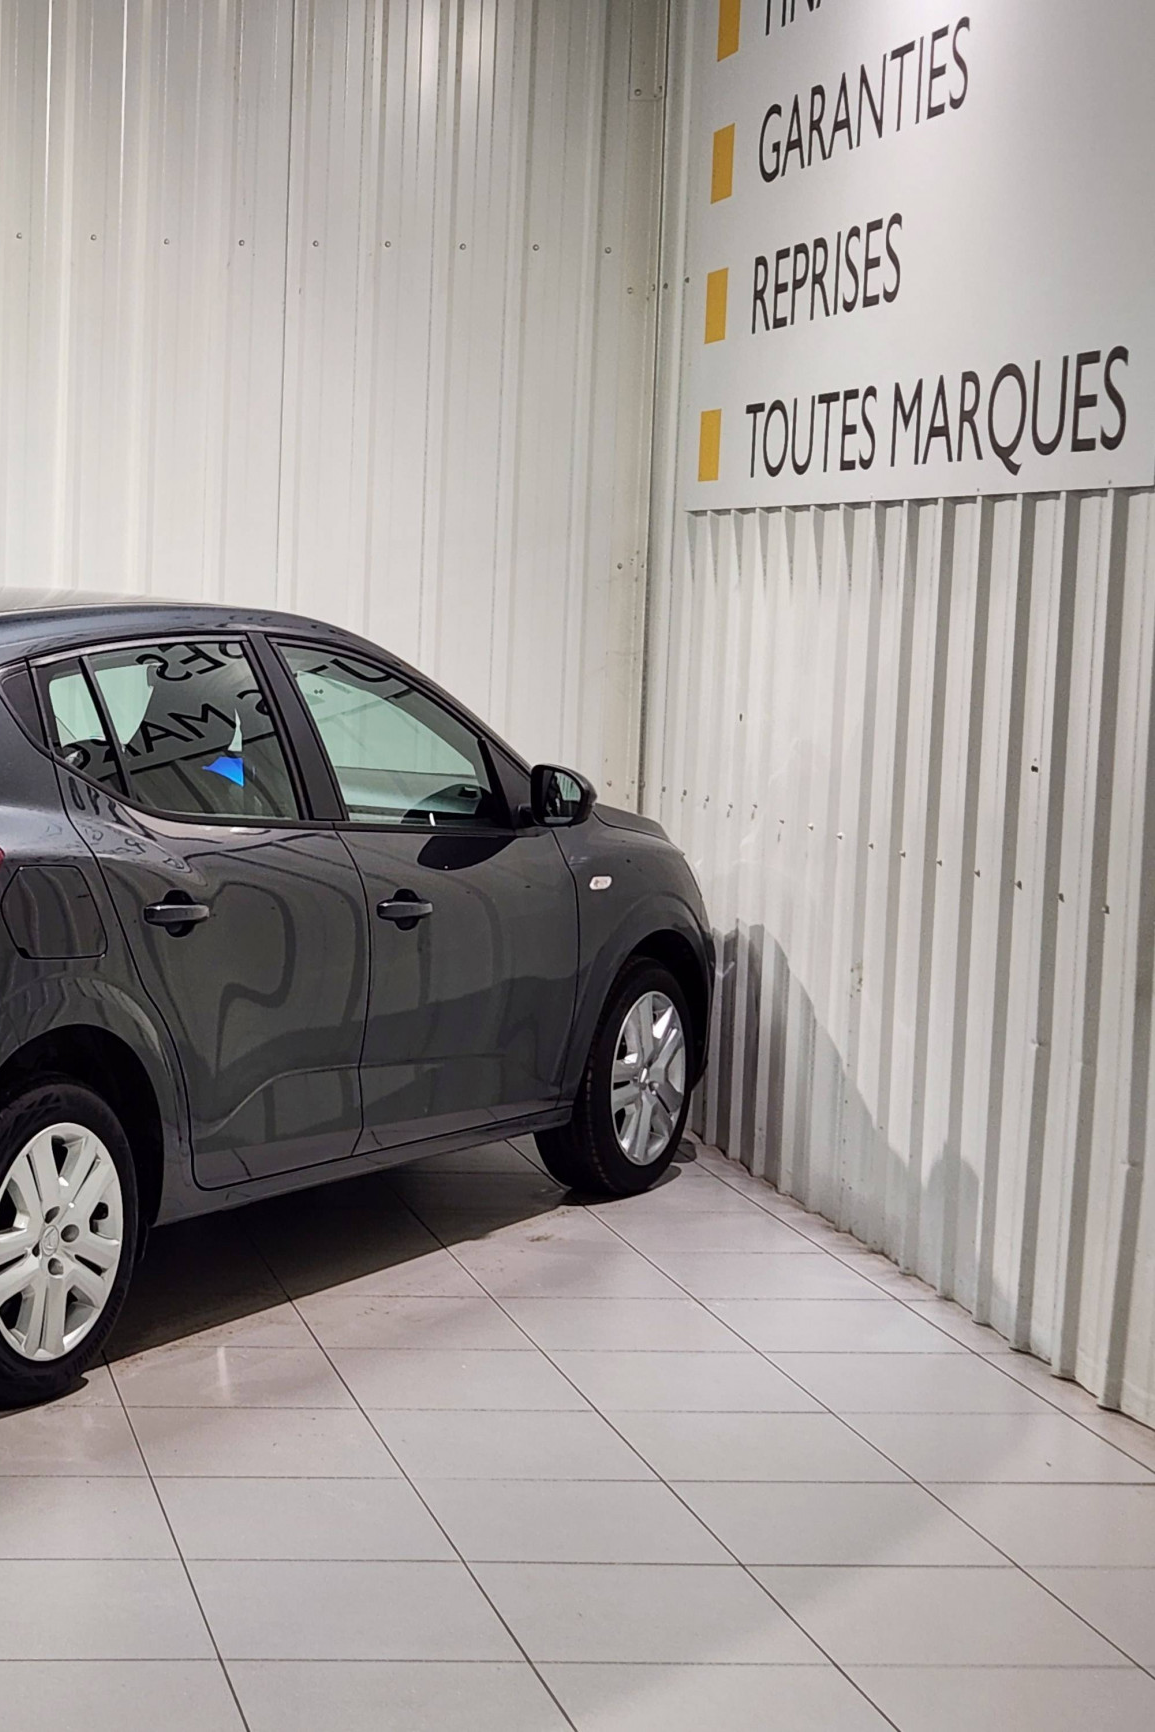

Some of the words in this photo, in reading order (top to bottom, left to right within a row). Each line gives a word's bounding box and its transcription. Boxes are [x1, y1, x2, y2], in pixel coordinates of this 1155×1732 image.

[758, 16, 970, 183] GARANTIES
[751, 212, 903, 335] REPRISES
[745, 385, 877, 478] TOUTES
[890, 345, 1129, 476] MARQUES
